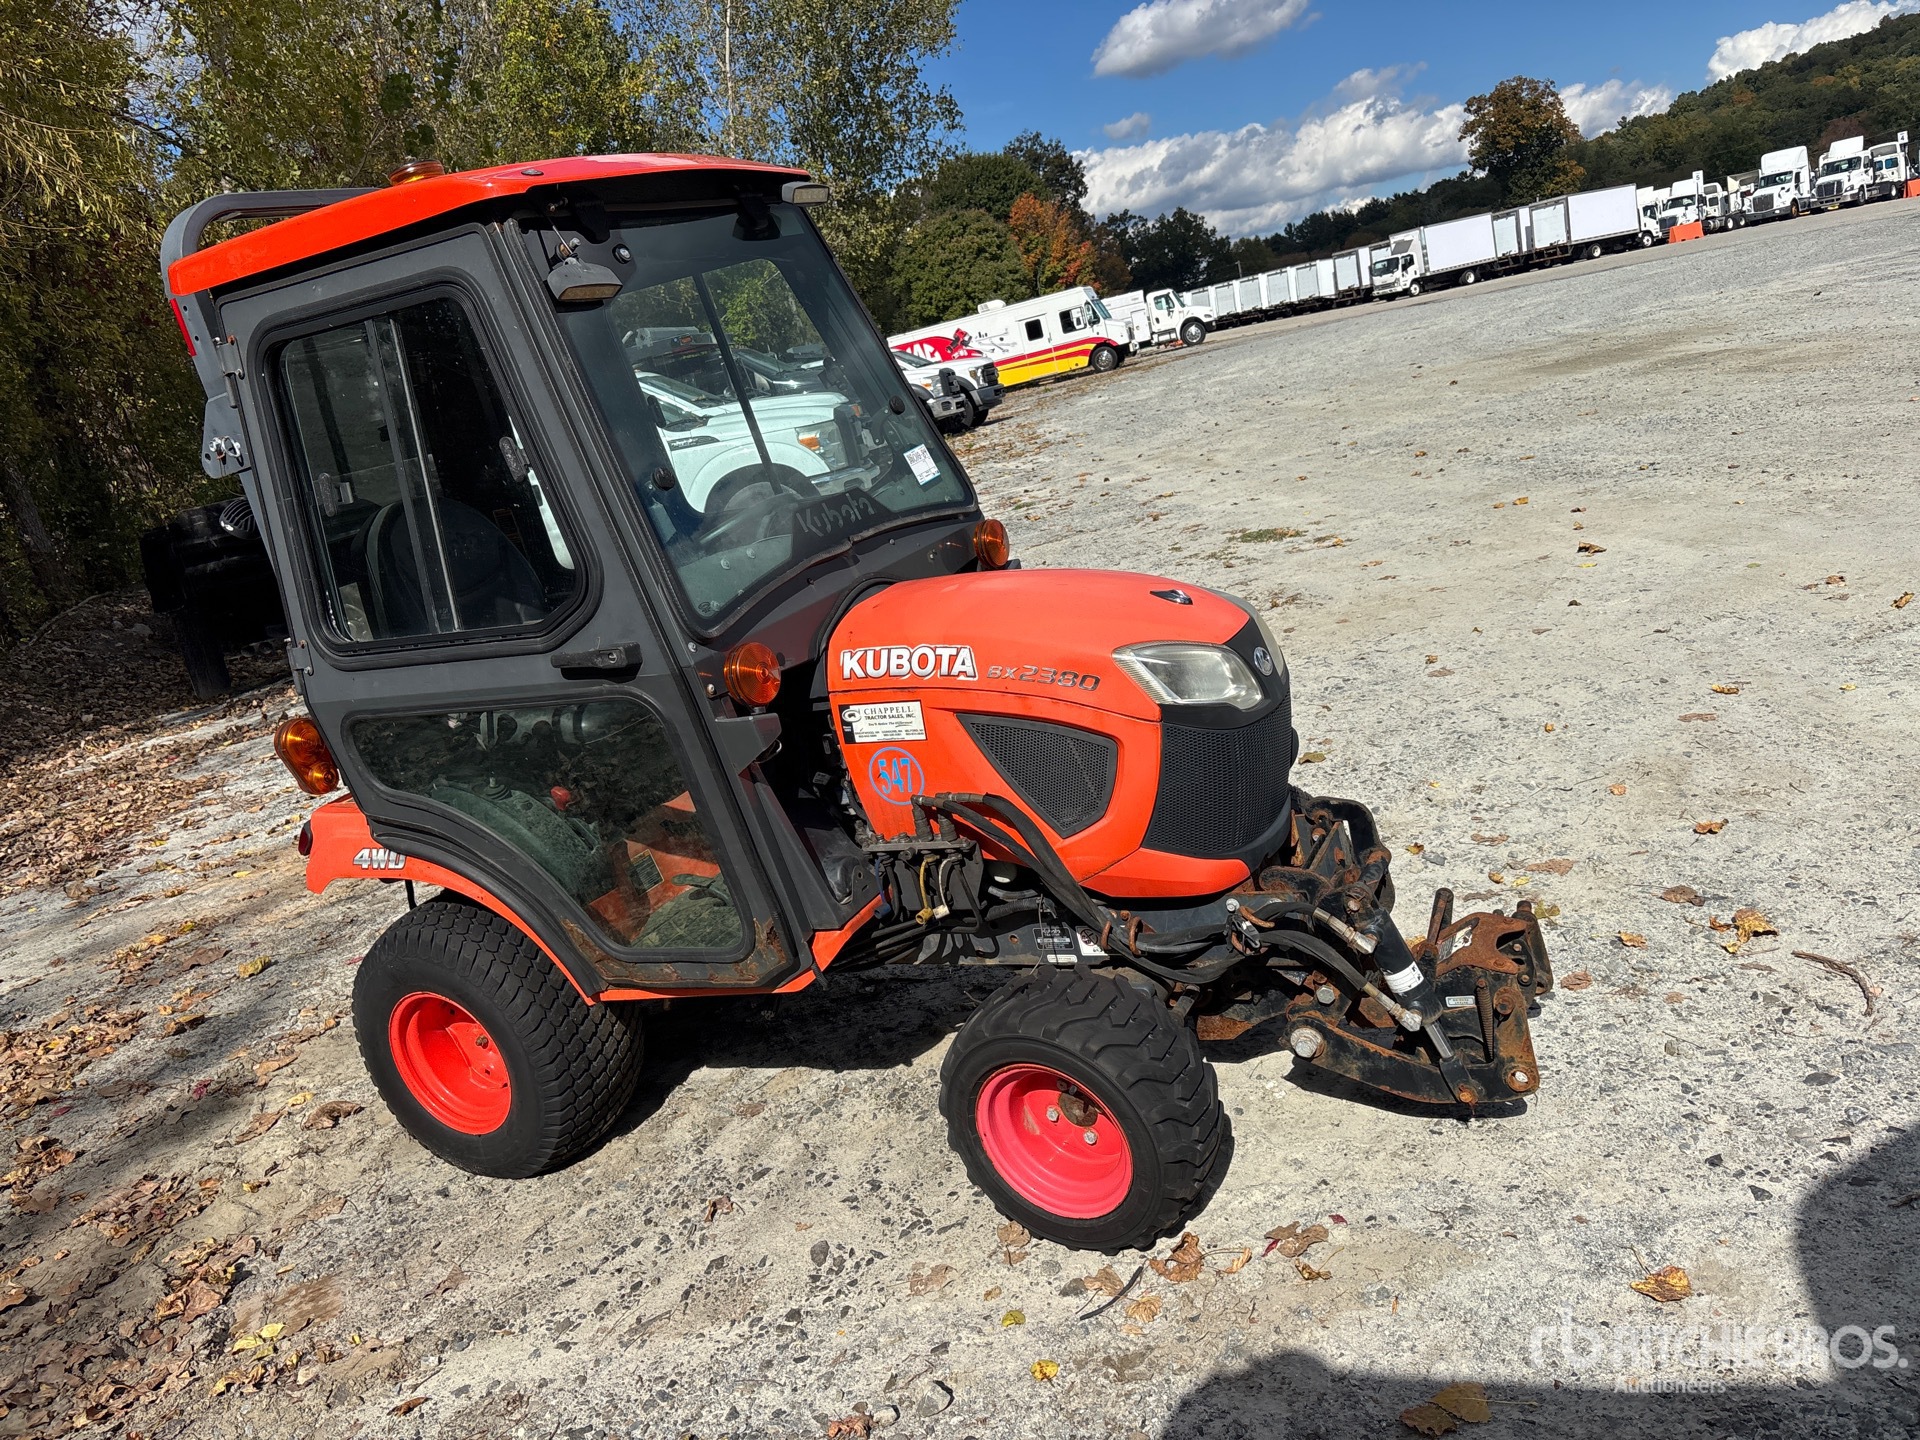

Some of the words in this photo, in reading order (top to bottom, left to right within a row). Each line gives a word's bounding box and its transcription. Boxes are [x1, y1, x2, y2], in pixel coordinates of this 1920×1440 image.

[796, 493, 875, 537] Kubota
[841, 645, 978, 681] KUBOTA
[986, 664, 1101, 691] BX2380
[864, 706, 913, 715] CHAPPELL
[877, 757, 913, 795] 547
[353, 847, 407, 870] 4WD
